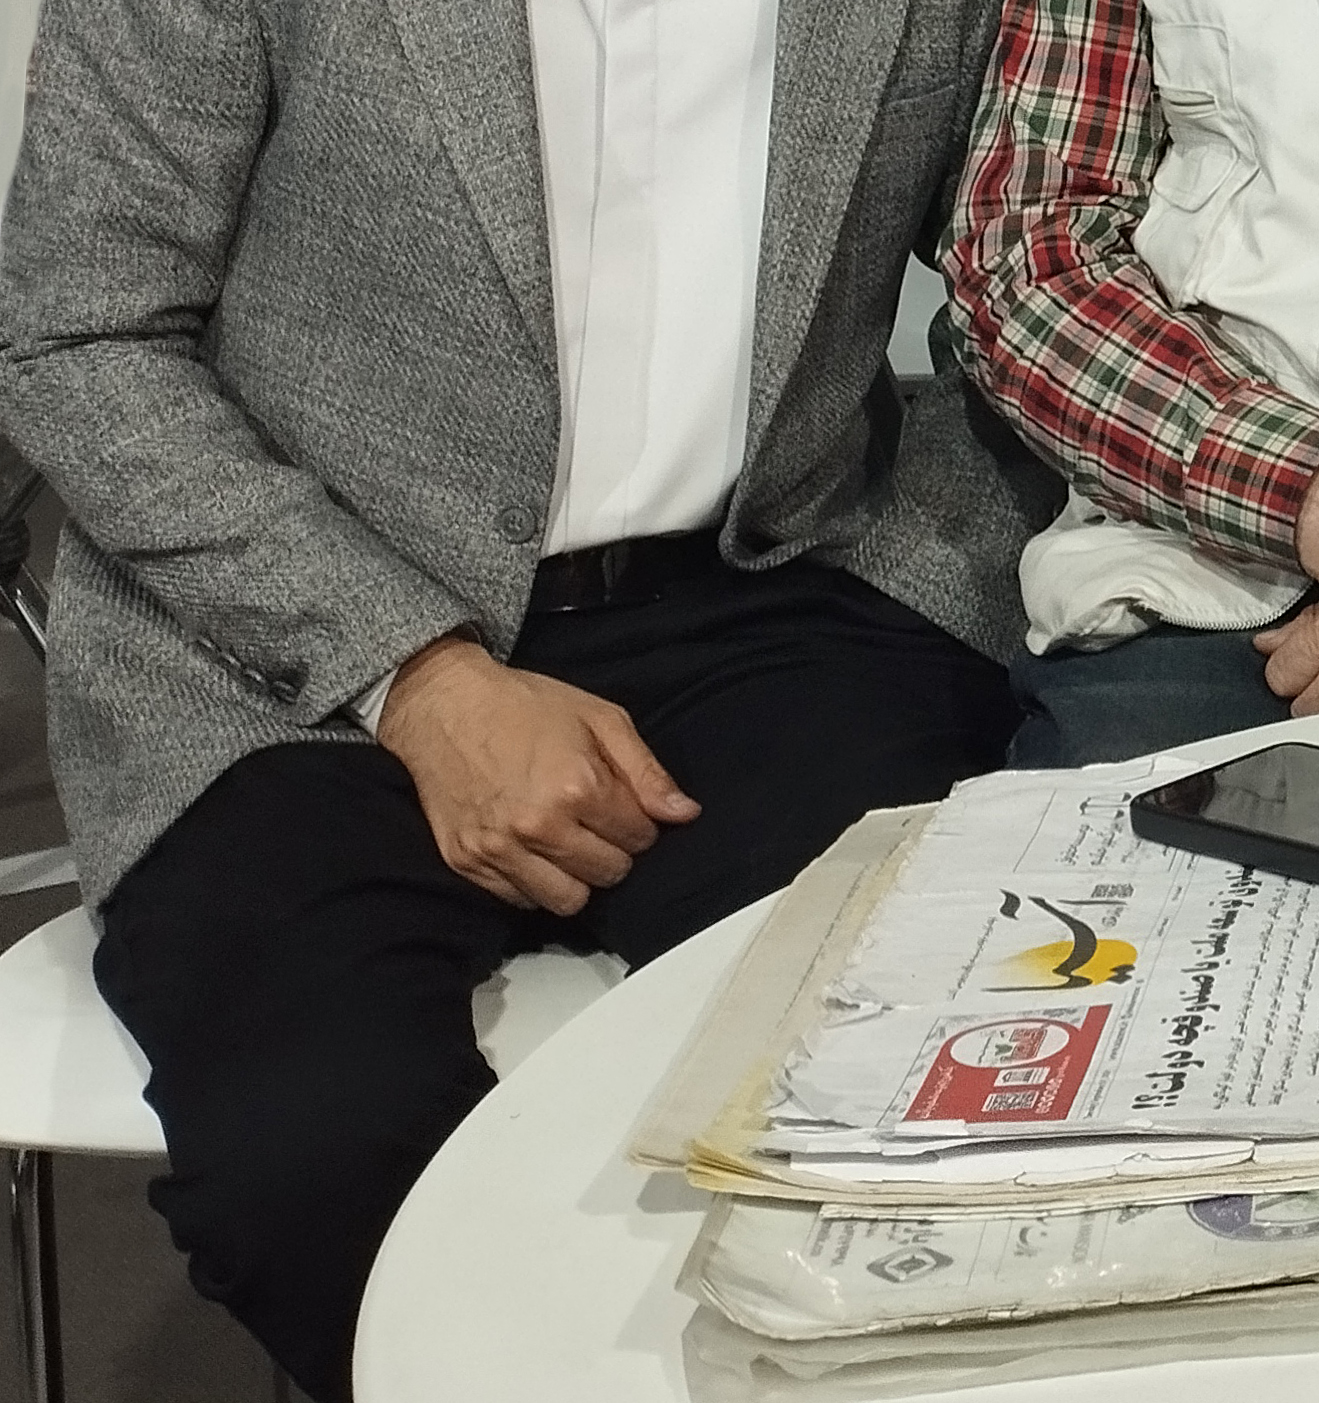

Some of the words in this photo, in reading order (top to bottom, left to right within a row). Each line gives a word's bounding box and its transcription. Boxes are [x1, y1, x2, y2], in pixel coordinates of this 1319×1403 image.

[1208, 899, 1255, 930] توسعه
[979, 888, 1138, 994] آسیا
[1191, 932, 1229, 958] ملت
[1181, 959, 1231, 974] یا
[1161, 974, 1221, 1047] صندوقچه
